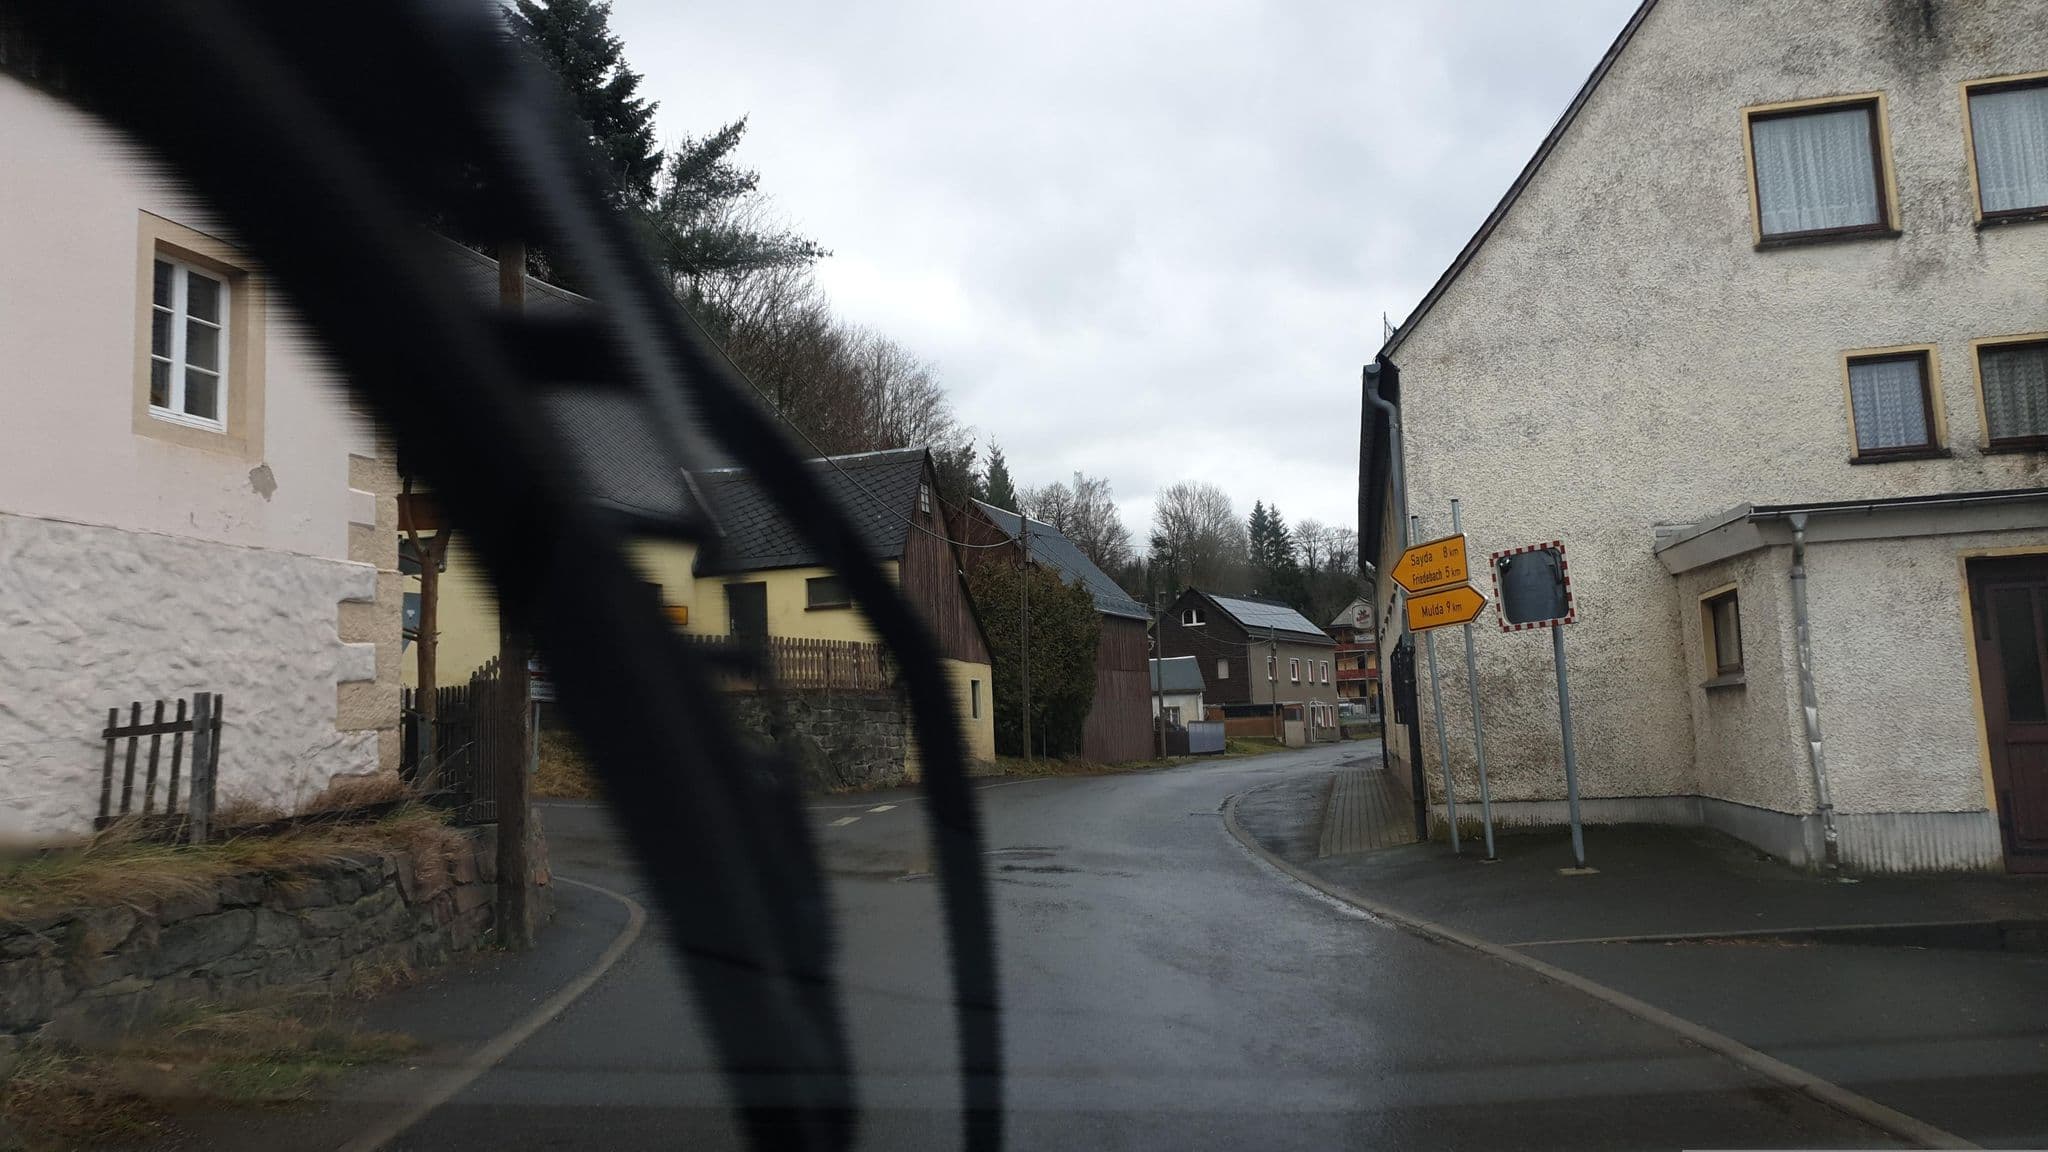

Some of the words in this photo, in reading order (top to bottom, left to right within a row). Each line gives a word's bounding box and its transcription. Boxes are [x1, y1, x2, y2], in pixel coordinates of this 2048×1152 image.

[1410, 552, 1433, 567] Sayda
[1443, 546, 1448, 558] 8
[1449, 547, 1459, 556] km
[1412, 568, 1442, 585] Friedebach
[1445, 566, 1450, 578] 5
[1451, 568, 1461, 577] km
[1421, 602, 1444, 617] Mulda
[1446, 601, 1451, 613] 9
[1453, 602, 1462, 612] km
